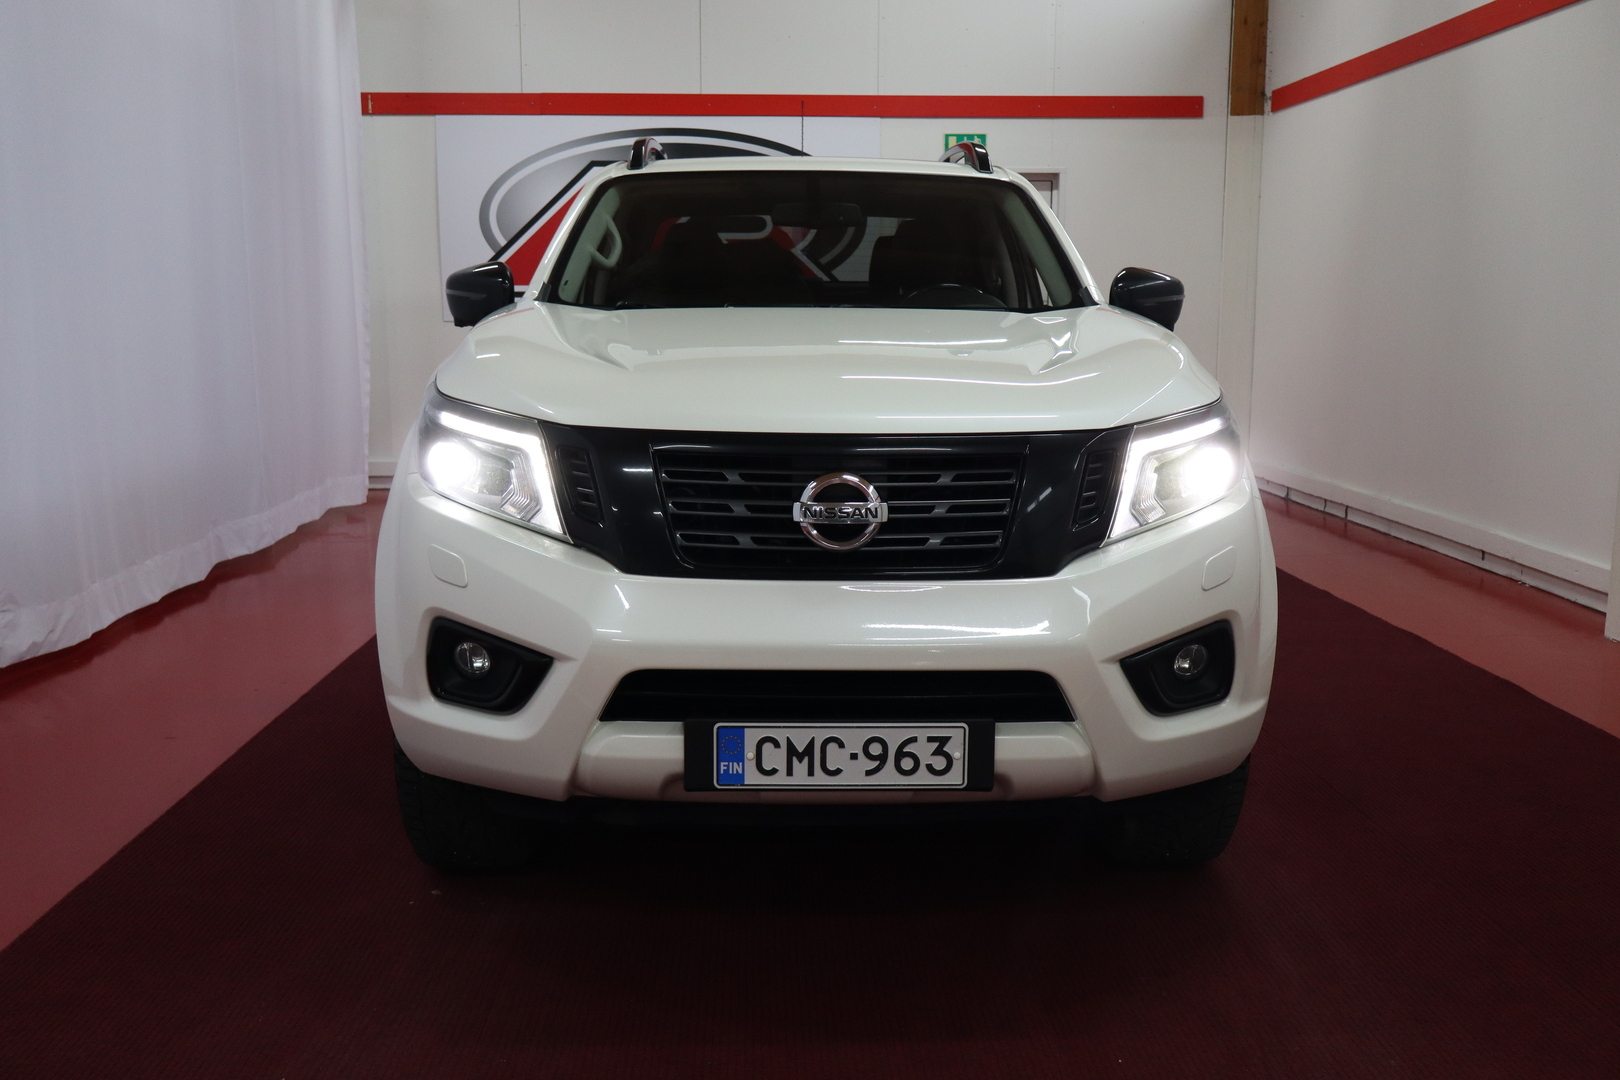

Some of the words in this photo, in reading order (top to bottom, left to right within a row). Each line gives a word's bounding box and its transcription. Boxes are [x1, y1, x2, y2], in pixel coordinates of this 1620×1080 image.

[803, 507, 878, 519] NISSAN
[755, 734, 954, 777] CMC-963
[720, 761, 743, 775] FIN
